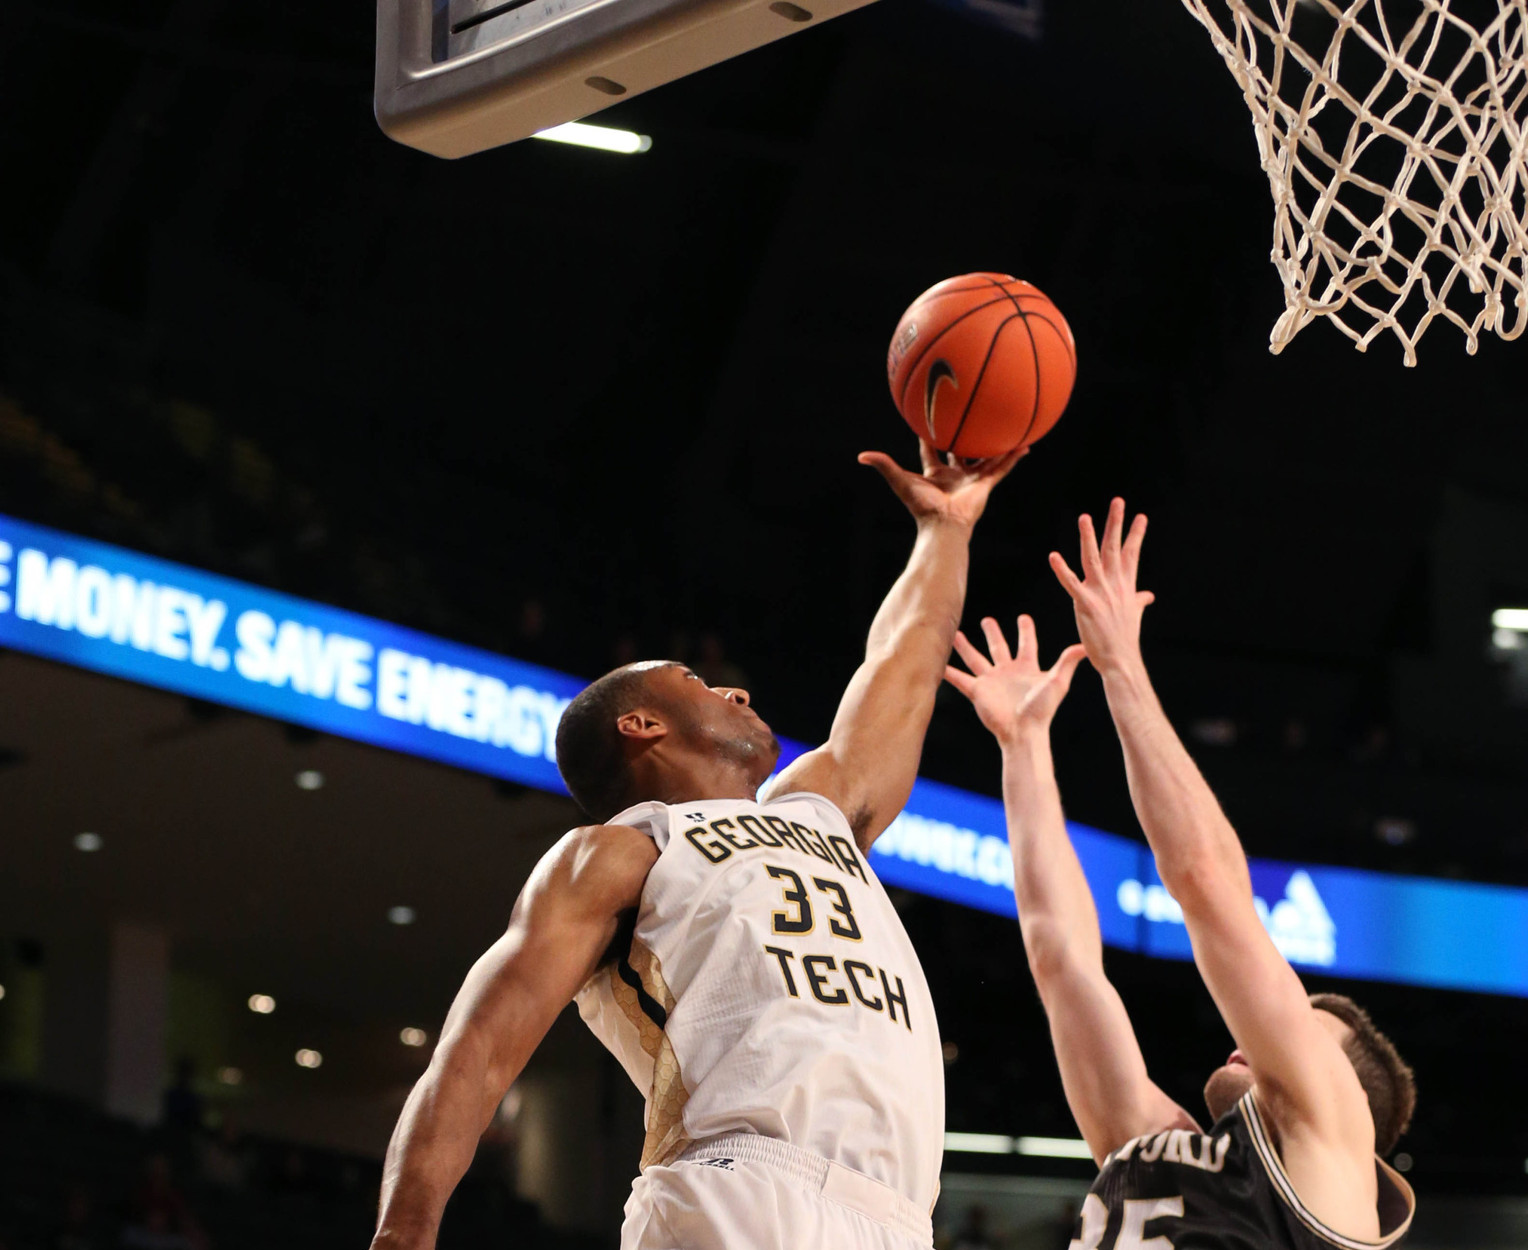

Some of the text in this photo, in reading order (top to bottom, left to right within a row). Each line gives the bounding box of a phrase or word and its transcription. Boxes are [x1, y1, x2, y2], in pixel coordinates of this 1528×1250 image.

[15, 548, 229, 672] MONEY.
[235, 610, 374, 710] SAVE
[684, 814, 871, 887] GEORGIA
[763, 863, 863, 942] 33
[763, 944, 912, 1034] TECH
